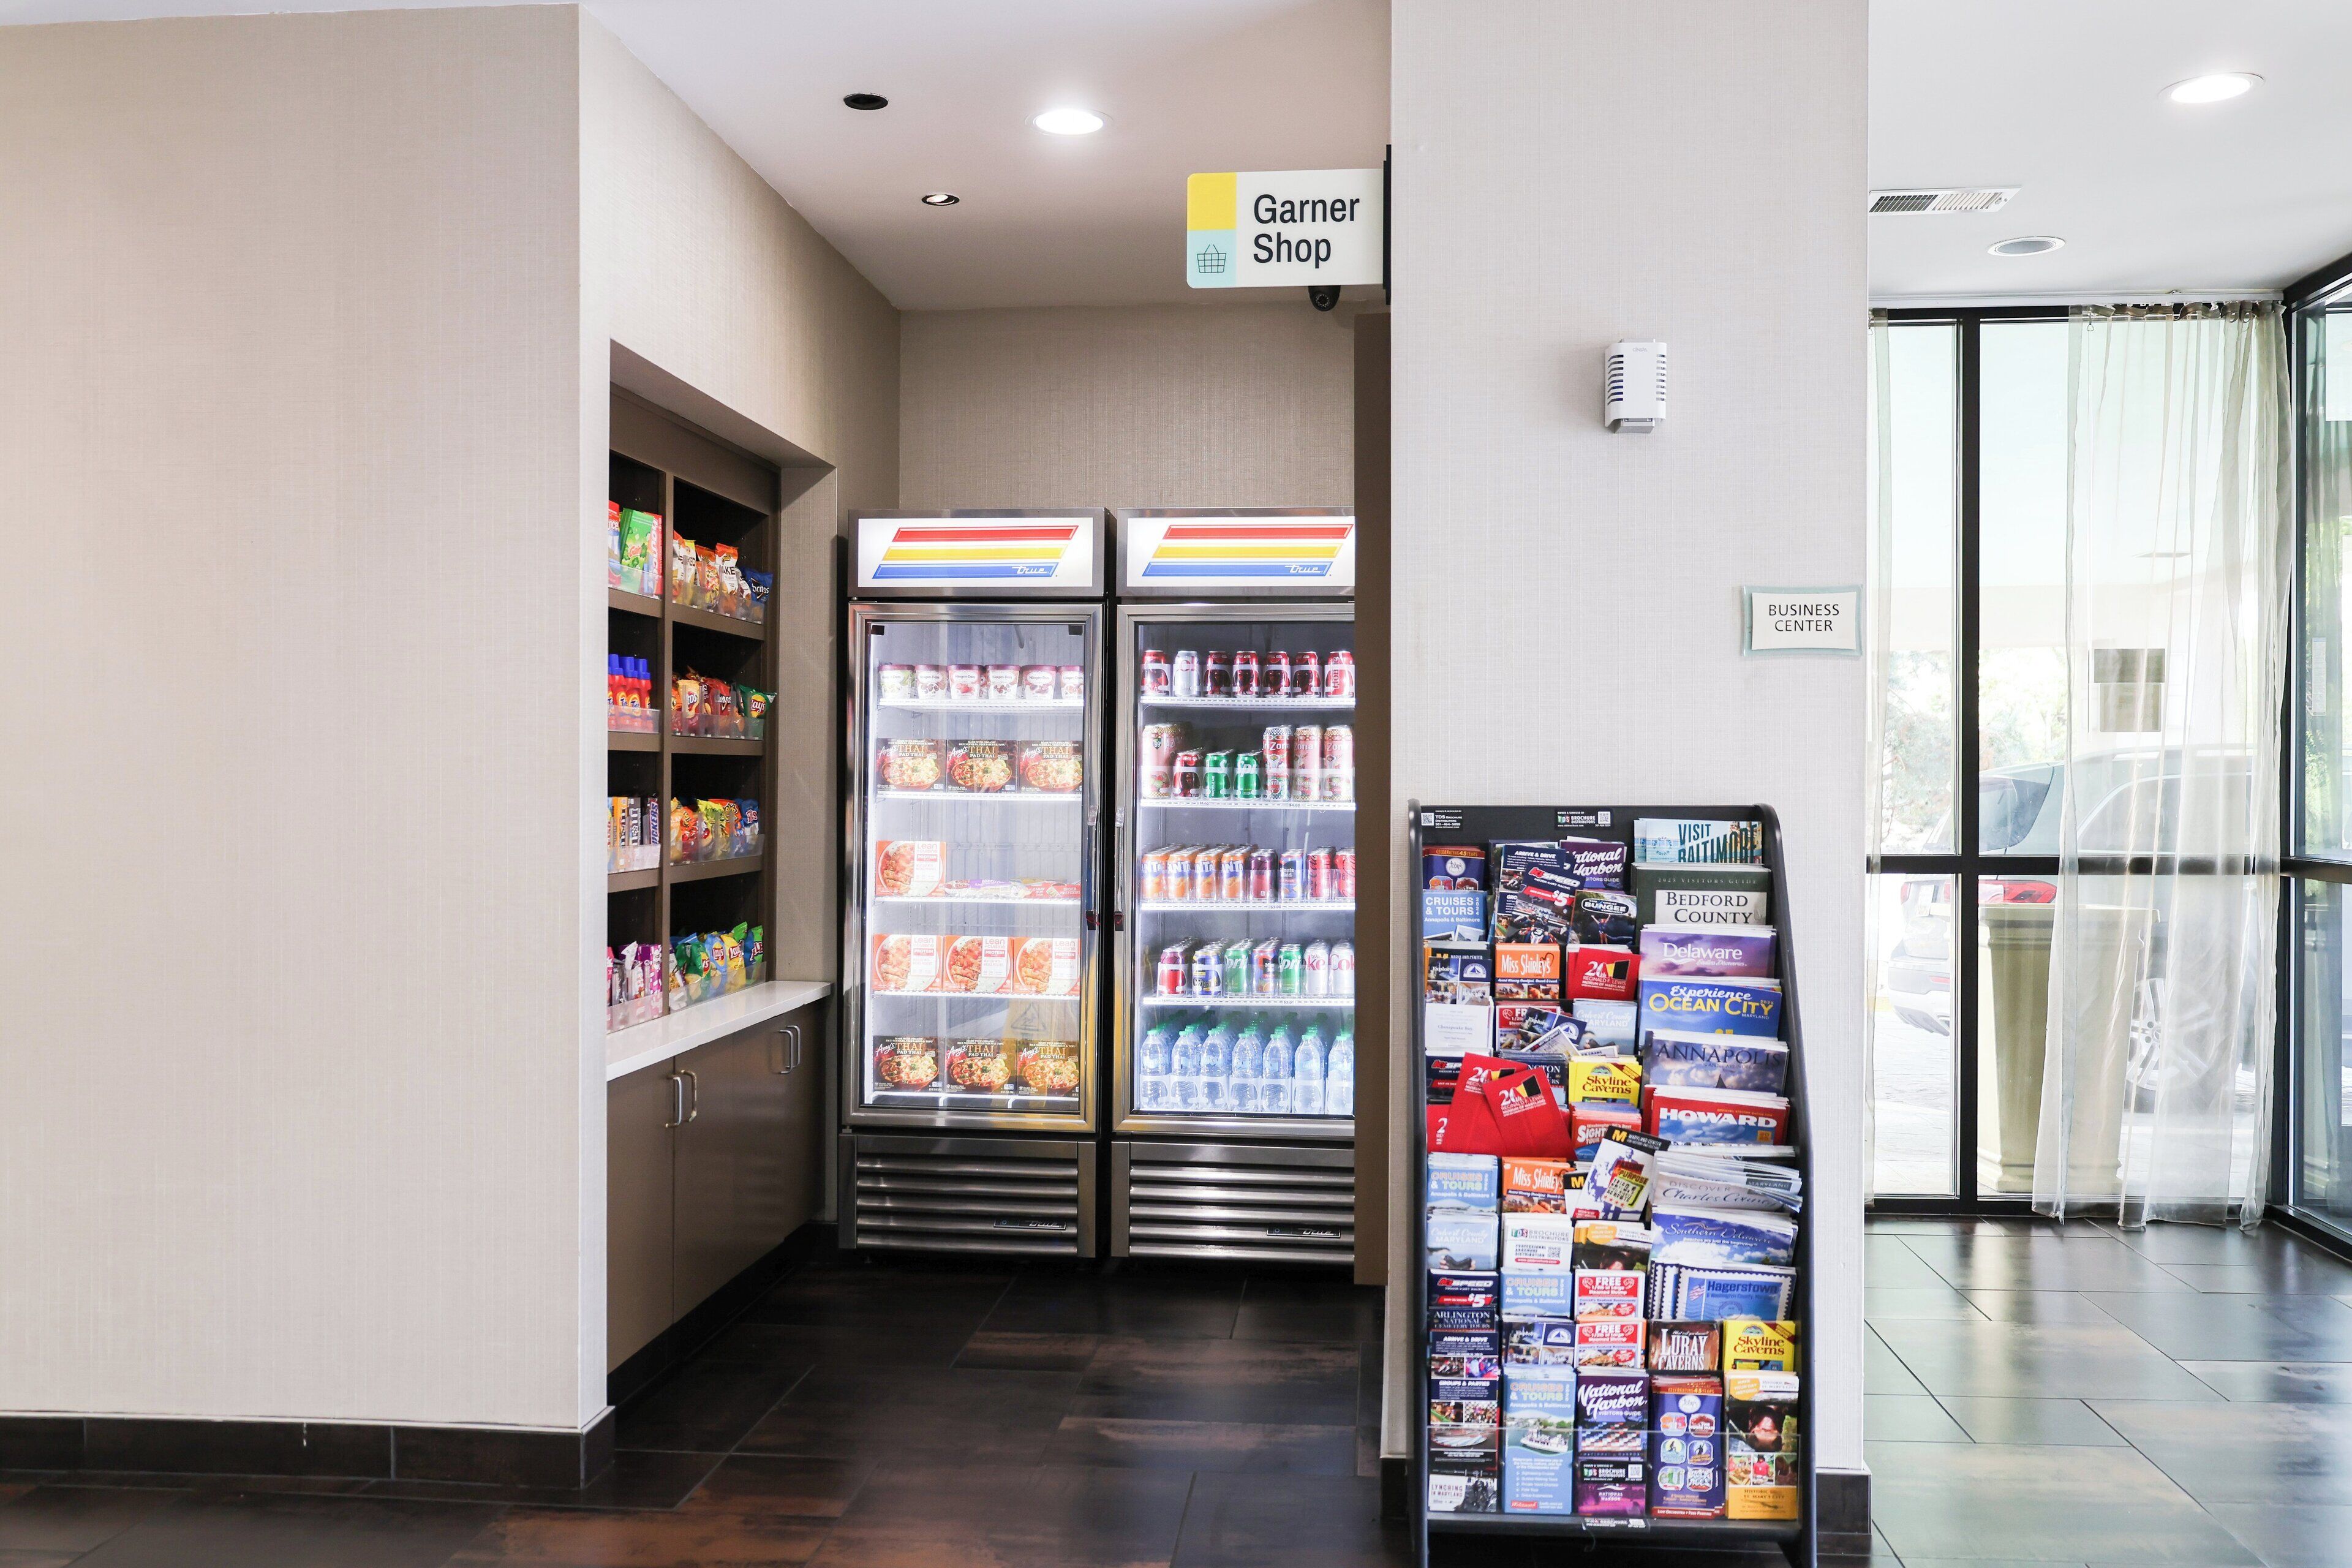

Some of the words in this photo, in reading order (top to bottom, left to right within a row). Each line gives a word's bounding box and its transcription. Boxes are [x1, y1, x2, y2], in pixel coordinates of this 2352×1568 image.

[1254, 194, 1360, 224] Garner
[1253, 232, 1332, 269] Shop
[1769, 604, 1839, 616] BUSINESS
[1774, 620, 1833, 631] CENTER
[878, 745, 898, 759] Amy's
[949, 746, 968, 760] Amy's
[1022, 747, 1042, 761] Amy's
[1678, 824, 1711, 845] VISIT
[1678, 823, 1758, 864] BALTIMORE
[1572, 847, 1623, 864] ational
[1425, 897, 1474, 906] CRUISES
[1551, 889, 1570, 907] $5
[1666, 891, 1748, 907] BEDFORD
[1585, 902, 1627, 913] BUNGEE
[1674, 908, 1753, 924] COUNTY
[1661, 942, 1743, 960] Delaware
[1501, 954, 1519, 973] Miss
[1670, 985, 1752, 1001] Experience
[1649, 993, 1719, 1012] OCEAN
[1724, 997, 1774, 1016] CITY
[876, 1042, 896, 1057] Amy's
[948, 1044, 967, 1058] Amy's
[1020, 1046, 1039, 1061] Amy's
[1039, 1047, 1066, 1055] THAI
[1657, 1044, 1781, 1067] ANNAPOLIS
[1582, 1083, 1632, 1094] Caverns
[1586, 1076, 1632, 1087] Skyline
[1659, 1107, 1777, 1128] HOWARD
[1430, 1172, 1483, 1182] CRUISES
[1512, 1166, 1531, 1187] Miss
[1619, 1169, 1649, 1185] PURPOSE
[1431, 1181, 1439, 1189] &
[1442, 1181, 1482, 1191] TOURS
[1669, 1180, 1731, 1192] DISCOVER
[1663, 1187, 1721, 1202] Charles
[1511, 1229, 1528, 1237] TDS
[1665, 1223, 1716, 1236] Southern
[1506, 1278, 1559, 1286] CRUISES
[1595, 1277, 1622, 1286] FREE
[1707, 1281, 1779, 1294] Hagerstown
[1517, 1287, 1559, 1297] TOURS
[1468, 1293, 1486, 1308] $5
[1595, 1324, 1621, 1333] FREE
[1660, 1328, 1709, 1356] LURAY
[1737, 1336, 1785, 1347] Skyline
[1733, 1344, 1785, 1355] Caverns
[1657, 1355, 1705, 1370] CAVERNS
[1510, 1382, 1564, 1392] CRUISES
[1578, 1379, 1644, 1407] National
[1510, 1392, 1518, 1401] &
[1521, 1392, 1564, 1401] TOURS
[1586, 1395, 1646, 1419] Harbor
